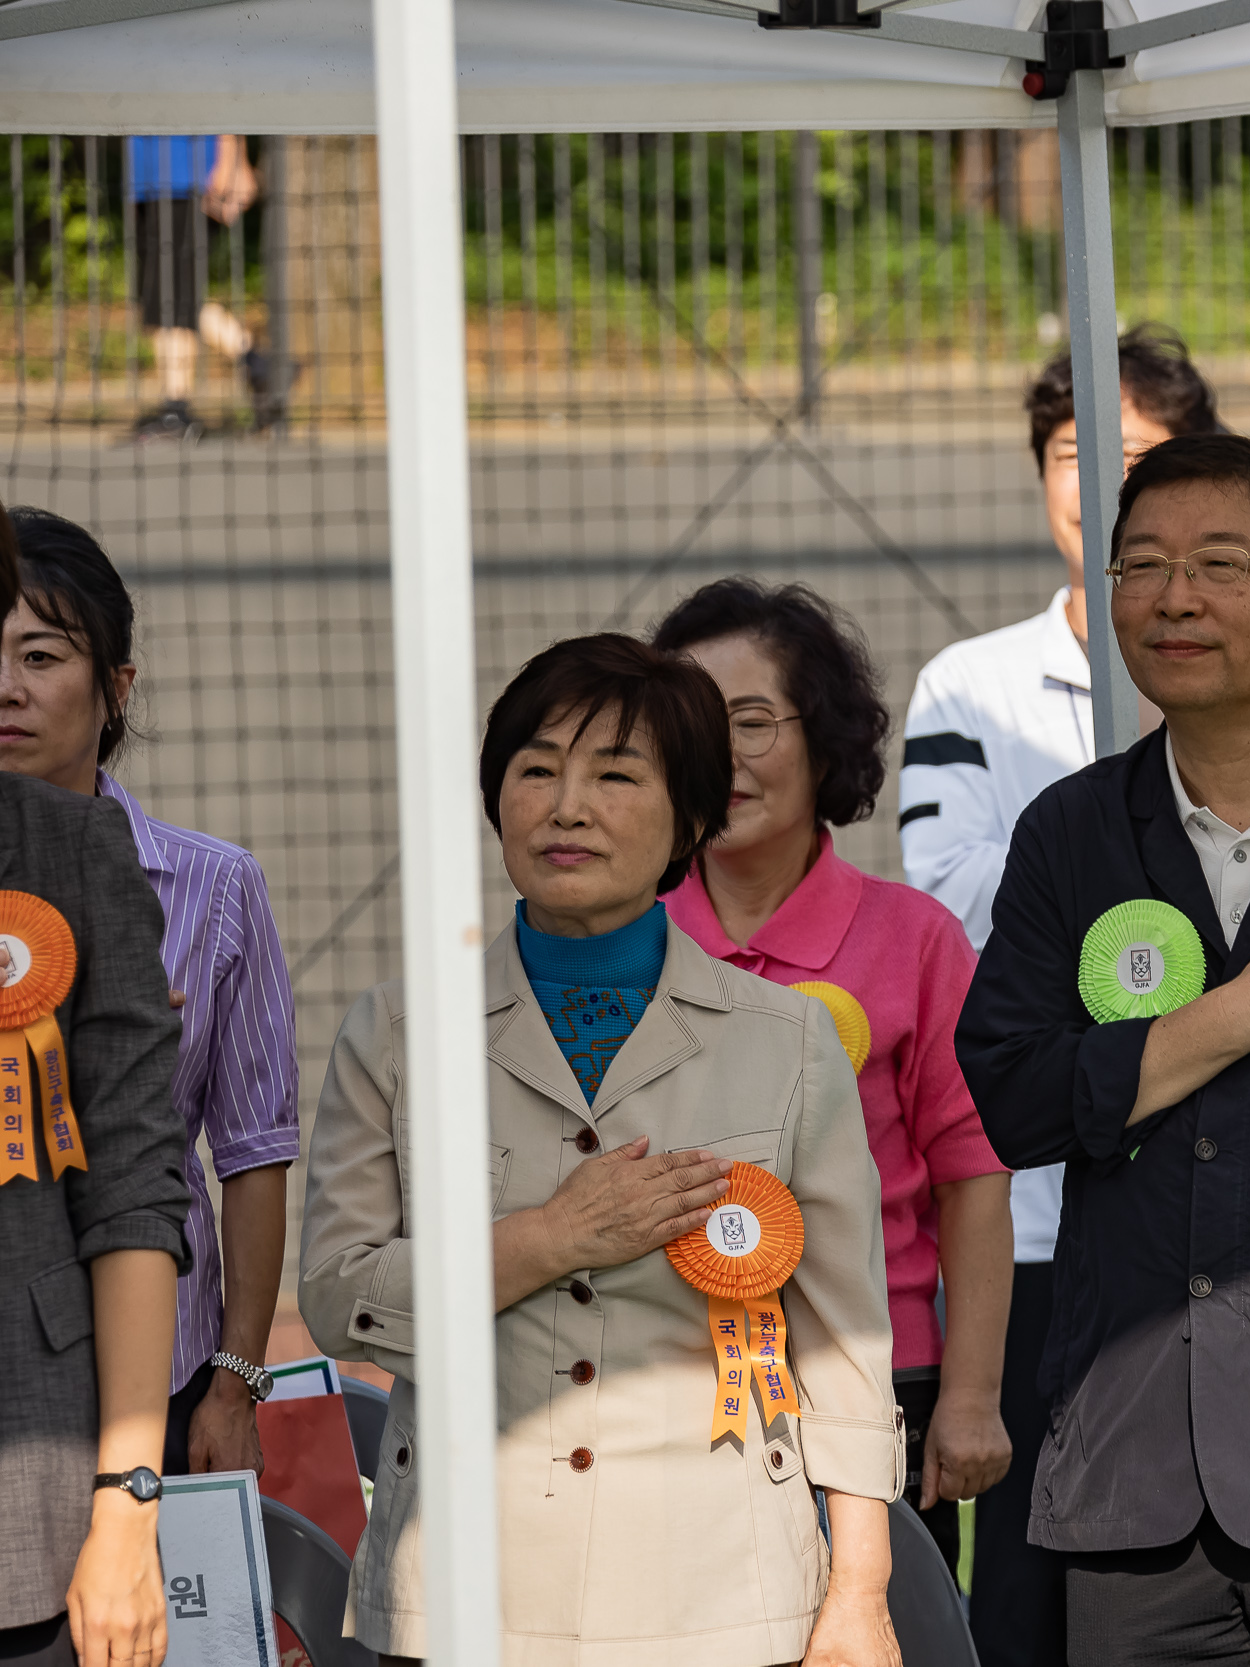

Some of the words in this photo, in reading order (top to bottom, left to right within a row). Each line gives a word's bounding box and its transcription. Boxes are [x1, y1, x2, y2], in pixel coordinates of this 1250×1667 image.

[1, 1057, 24, 1160] 국회의원
[718, 1319, 743, 1416] 국회의원
[758, 1311, 786, 1401] 광진구축구협회
[168, 1574, 207, 1619] 원
